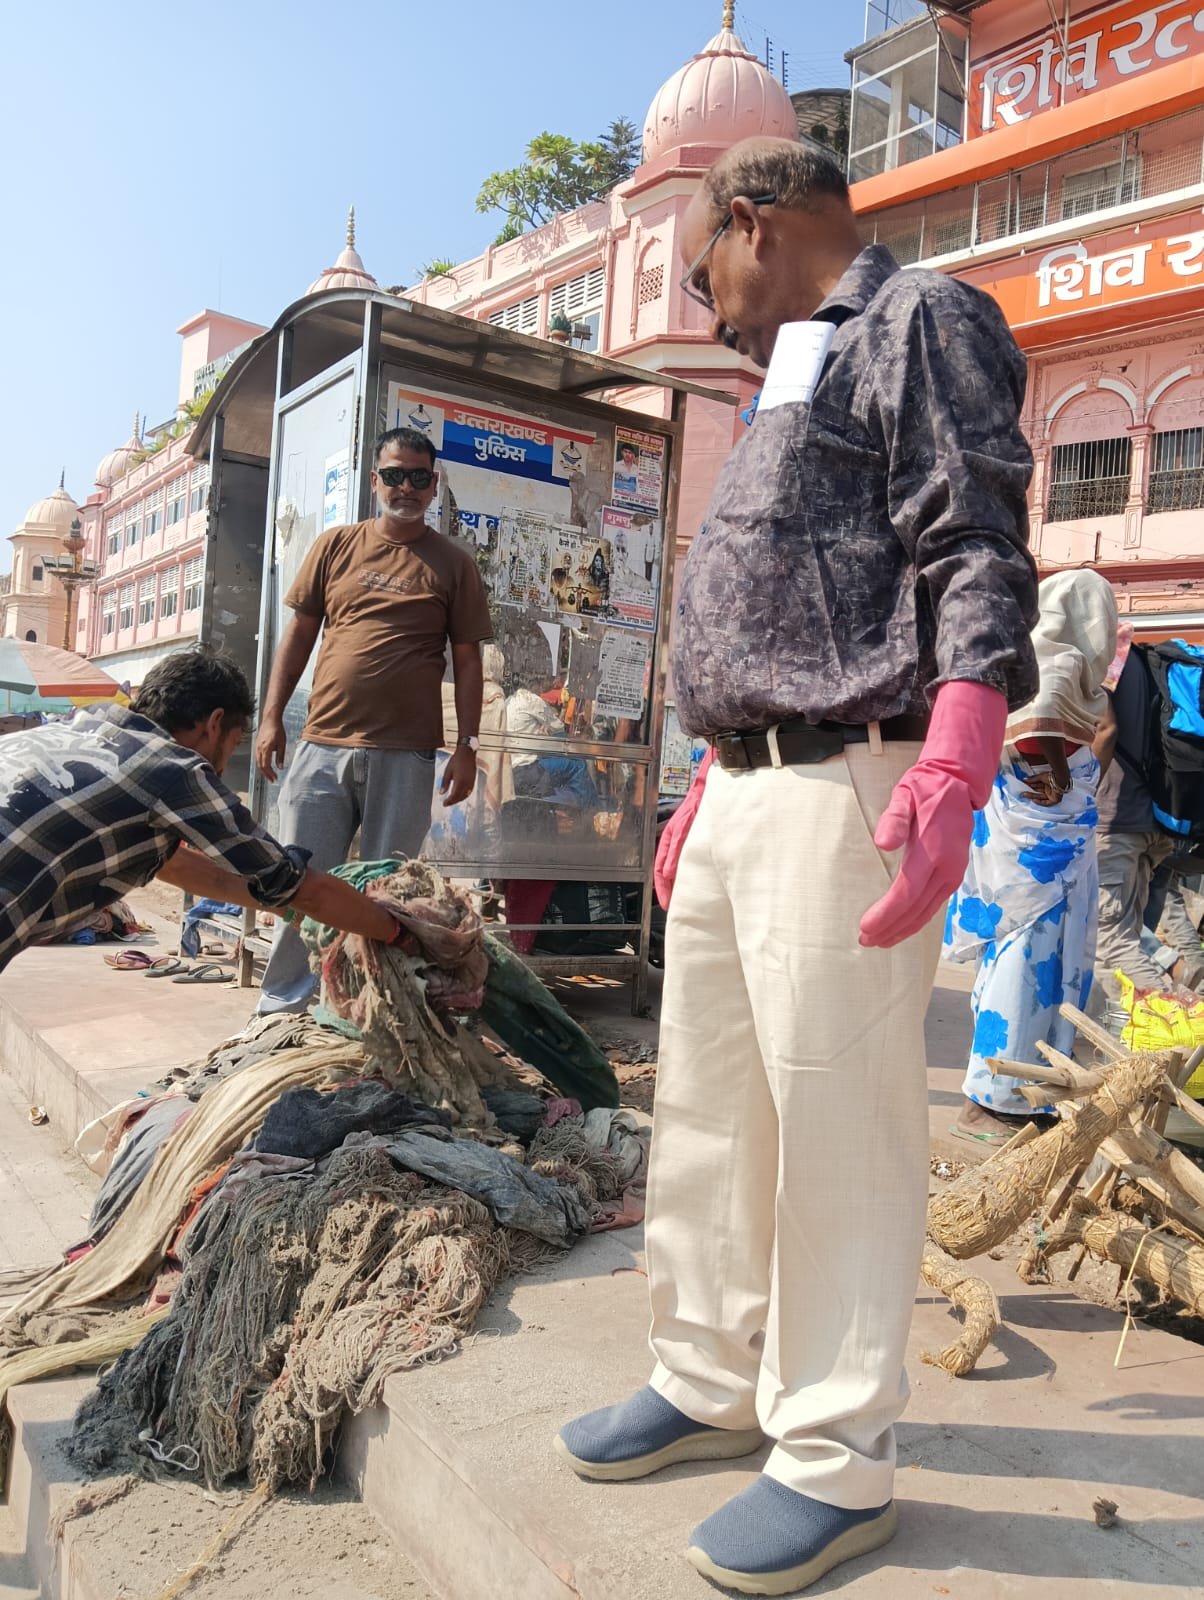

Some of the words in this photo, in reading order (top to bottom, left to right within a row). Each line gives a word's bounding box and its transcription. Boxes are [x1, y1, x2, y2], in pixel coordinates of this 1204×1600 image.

[980, 30, 1103, 131] शिव
[1035, 242, 1152, 308] शिव
[453, 409, 548, 446] उत्तराखण्ड
[473, 434, 527, 463] पुलिस
